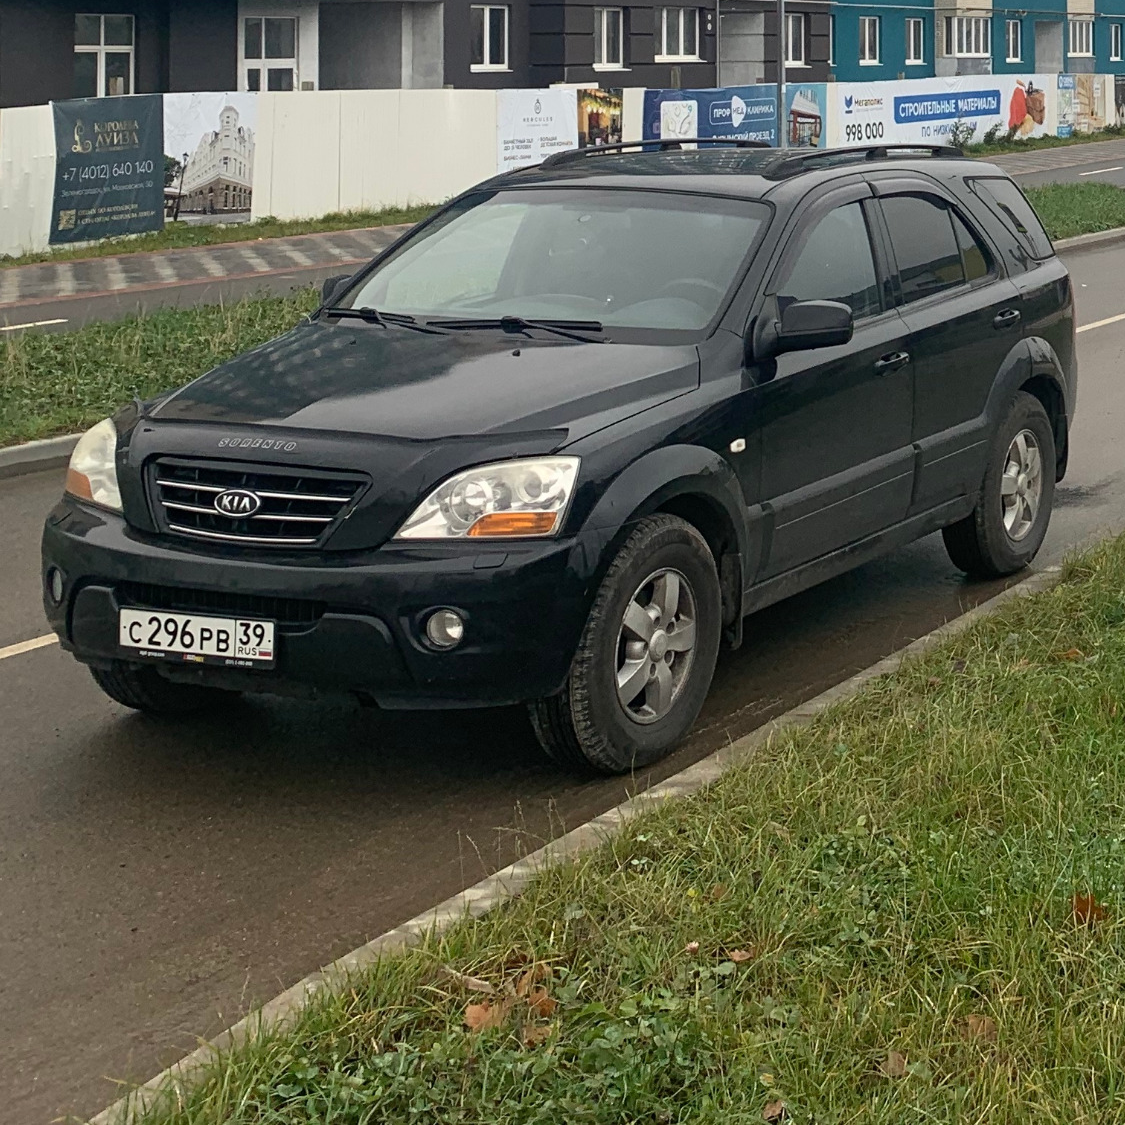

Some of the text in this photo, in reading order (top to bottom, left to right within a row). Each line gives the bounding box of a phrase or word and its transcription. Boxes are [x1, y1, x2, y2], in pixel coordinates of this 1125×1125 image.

[854, 97, 884, 108] Мегаполис
[899, 96, 998, 118] СТРОИТЕЛЬНЫЕ МАТЕРИАЛЫ
[713, 108, 731, 118] ПРОФ
[746, 105, 774, 114] КЛИНИКА
[94, 120, 139, 133] КОРОЛЕВА
[845, 121, 884, 142] 998 000
[921, 126, 931, 137] ПО
[933, 123, 957, 137] НИЗКИ
[770, 128, 775, 139] 2
[62, 160, 154, 183] +7 (4012) 640 140
[218, 438, 297, 451] SORENTO
[221, 495, 251, 511] KIA
[238, 622, 265, 647] 39
[237, 646, 257, 656] RUS
